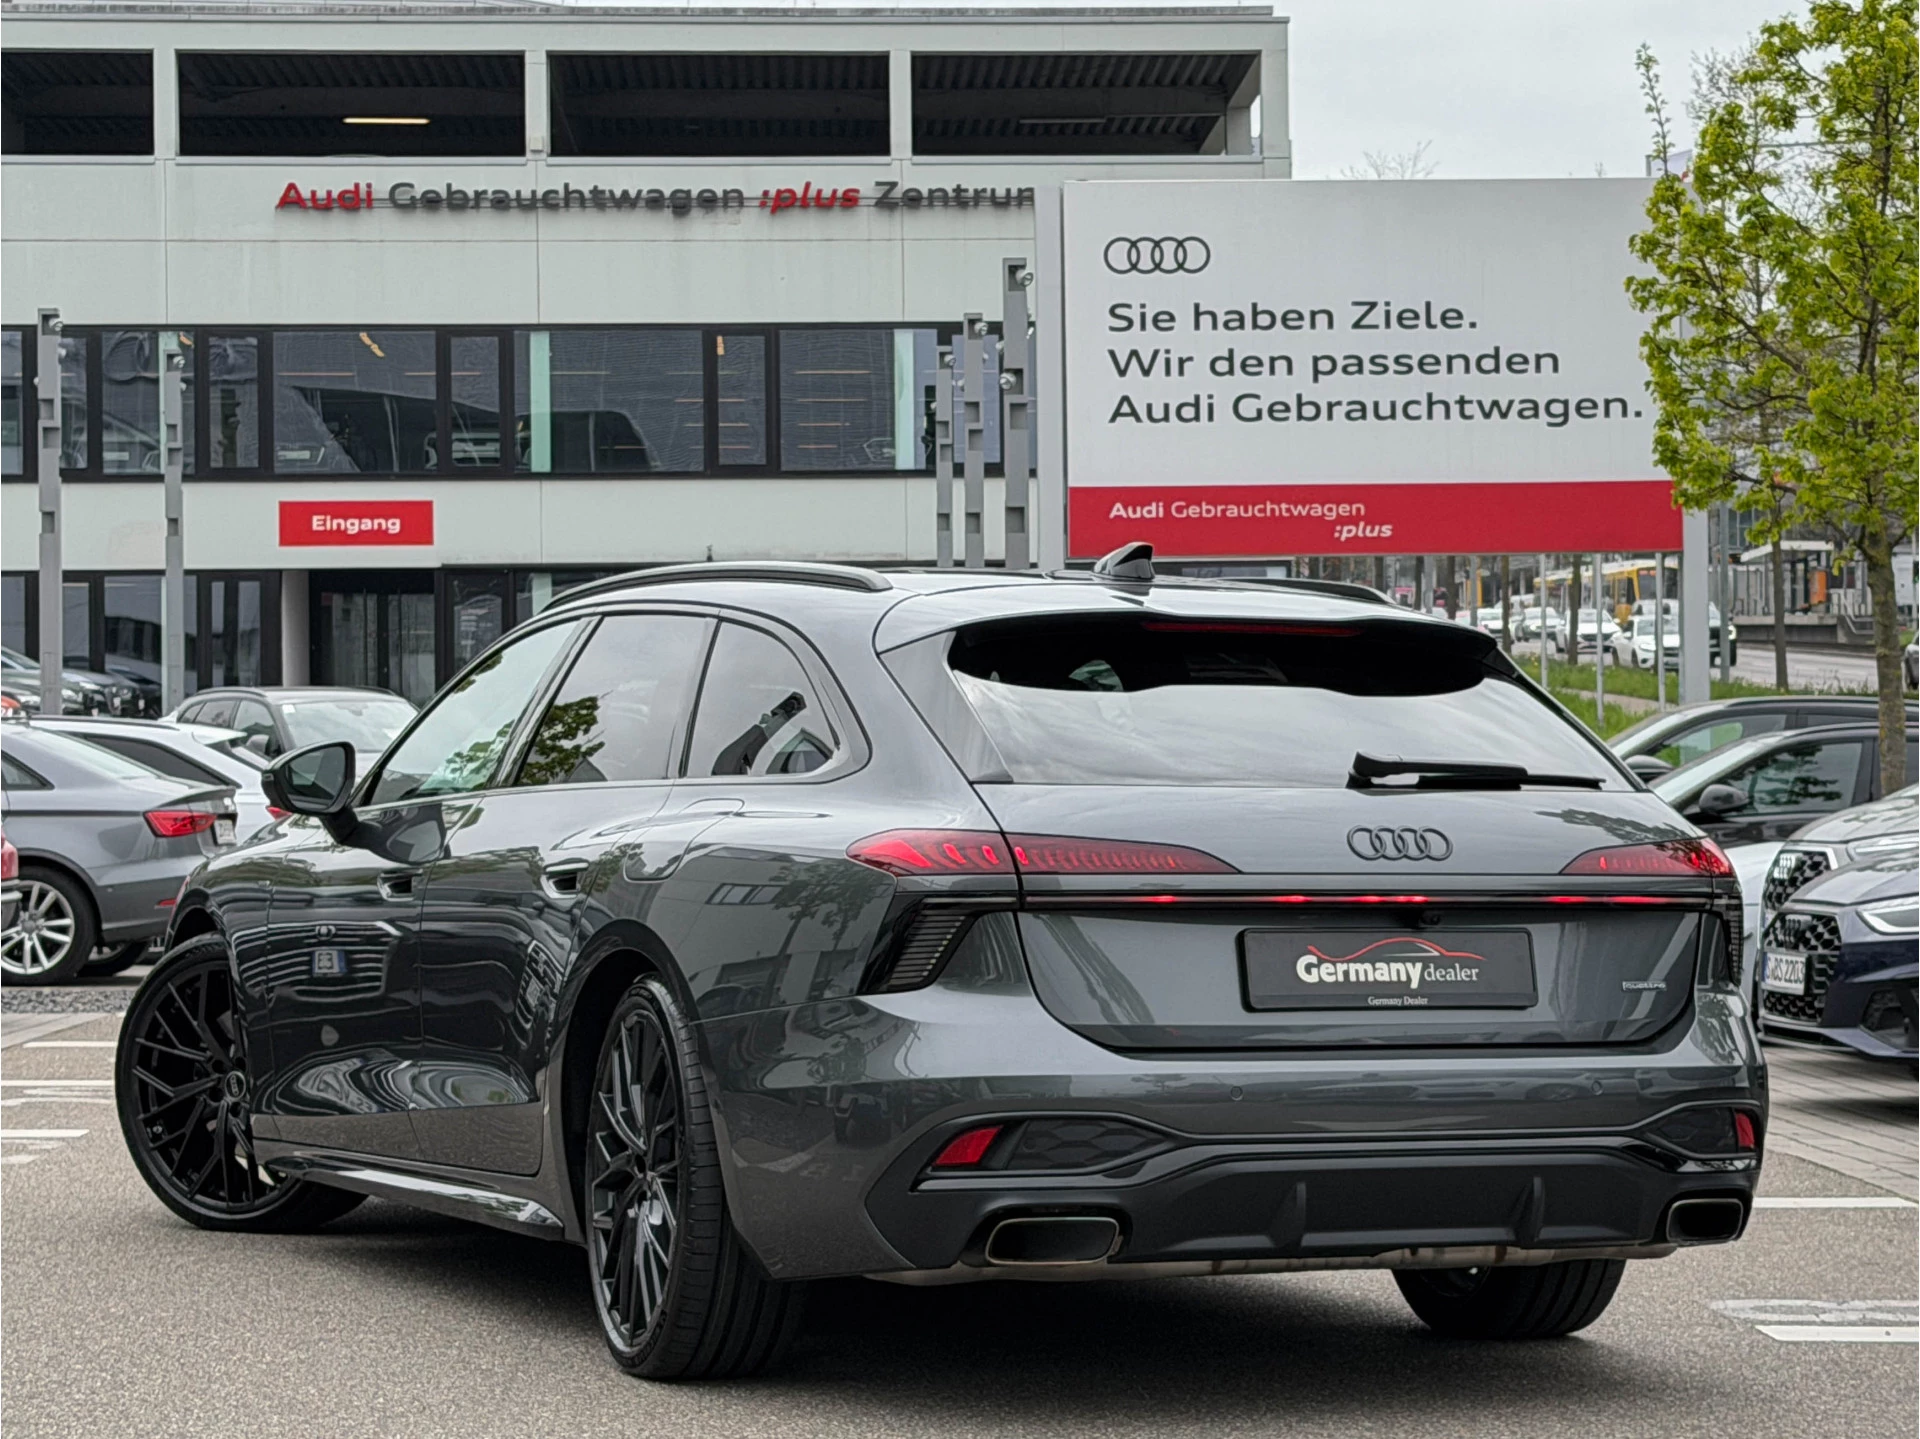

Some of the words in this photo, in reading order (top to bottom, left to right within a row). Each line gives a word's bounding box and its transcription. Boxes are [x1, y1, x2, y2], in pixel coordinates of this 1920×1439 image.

[277, 182, 373, 210] Audi
[388, 182, 744, 214] Gebrauchtwagen
[759, 181, 860, 214] :plus
[1108, 302, 1176, 333] Sie
[1193, 302, 1335, 332] haben
[1351, 300, 1478, 331] Ziele.
[1107, 348, 1194, 378] Wir
[1209, 347, 1294, 377] den
[1312, 345, 1560, 384] passenden
[1108, 394, 1215, 424] Audi
[1231, 391, 1643, 428] Gebrauchtwagen.
[311, 514, 401, 534] Eingang
[1108, 501, 1164, 519] Audi
[1170, 500, 1365, 520] Gebrauchtwagen
[1332, 521, 1393, 540] :plus
[1296, 955, 1422, 989] Germany
[1424, 963, 1480, 982] dealer
[1367, 996, 1402, 1006] Germany
[1403, 996, 1429, 1006] Dealer
